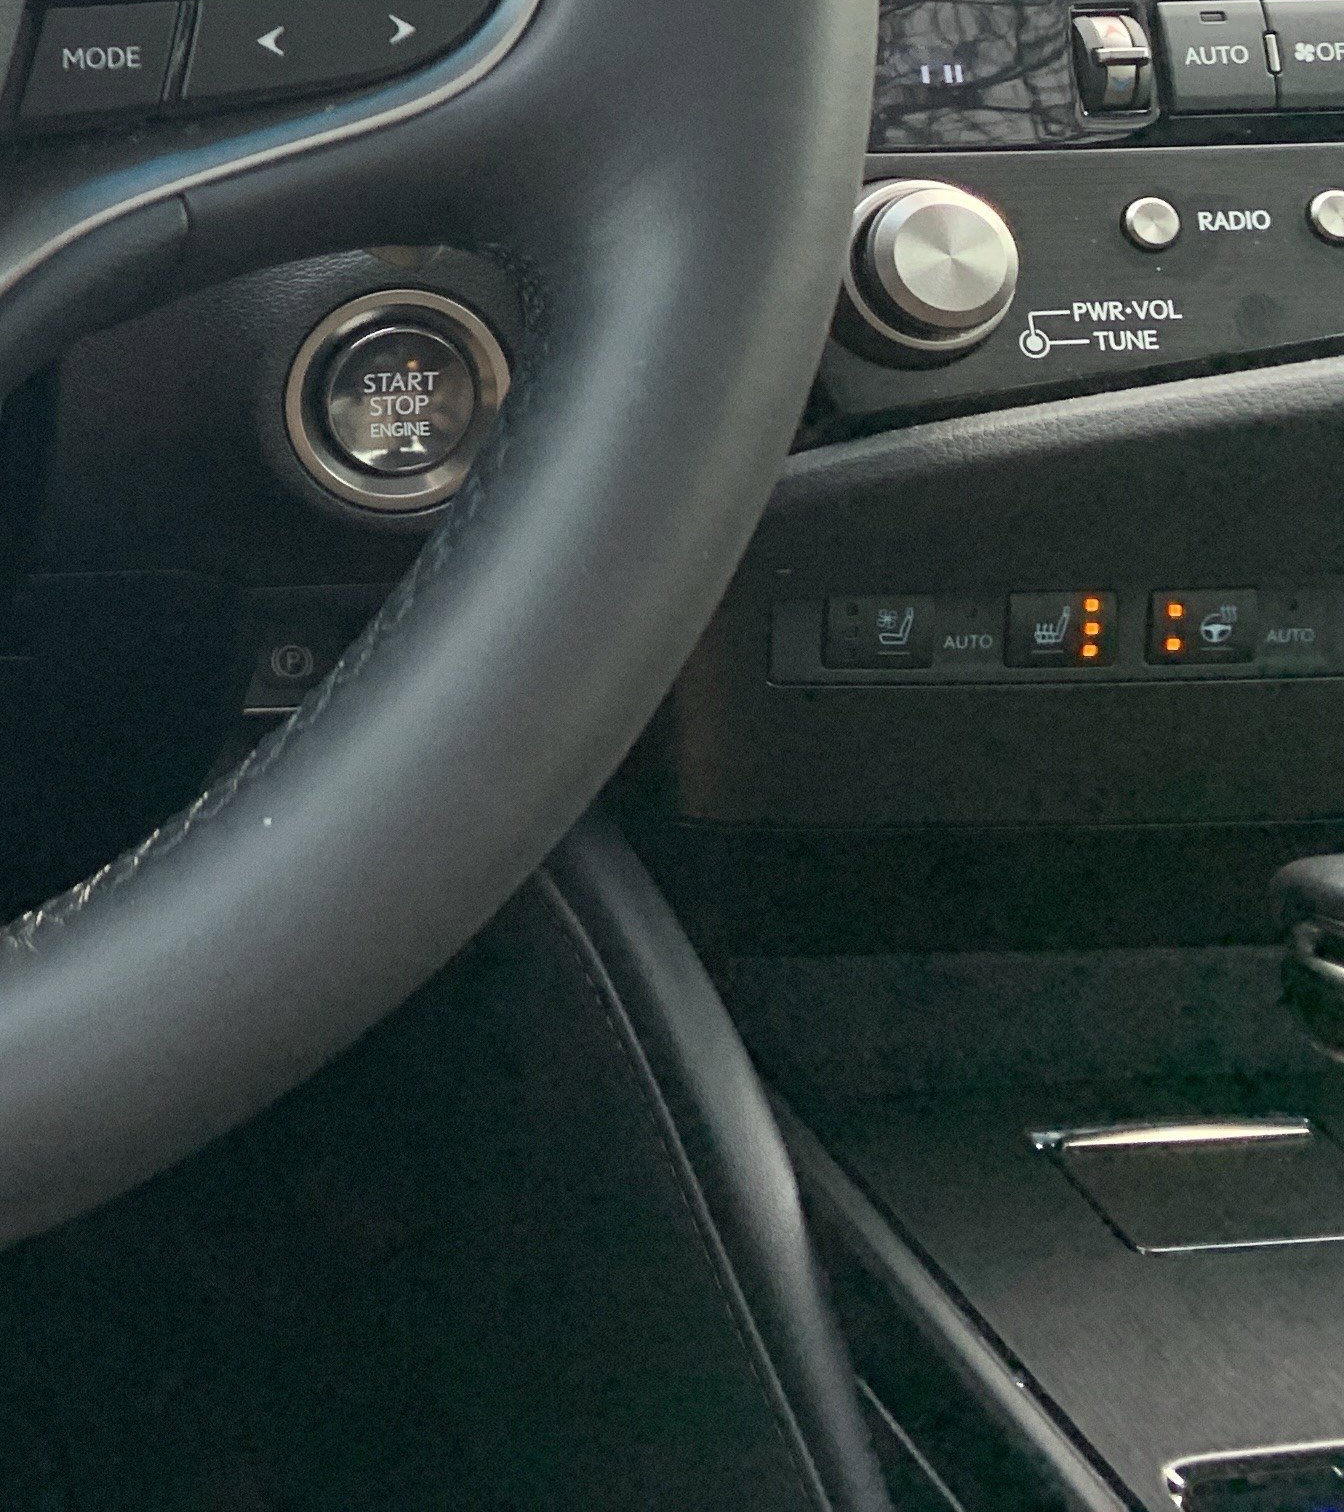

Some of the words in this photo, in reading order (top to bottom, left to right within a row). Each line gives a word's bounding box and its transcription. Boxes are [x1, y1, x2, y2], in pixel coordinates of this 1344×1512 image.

[61, 46, 142, 70] MODE
[1184, 44, 1250, 67] AUTO
[1197, 209, 1272, 233] RADIO
[1092, 330, 1160, 352] TUNE
[363, 371, 440, 394] START
[369, 394, 430, 417] STOP
[370, 420, 431, 439] ENGINE
[943, 633, 993, 650] AUTO
[1266, 627, 1315, 643] AUTO
